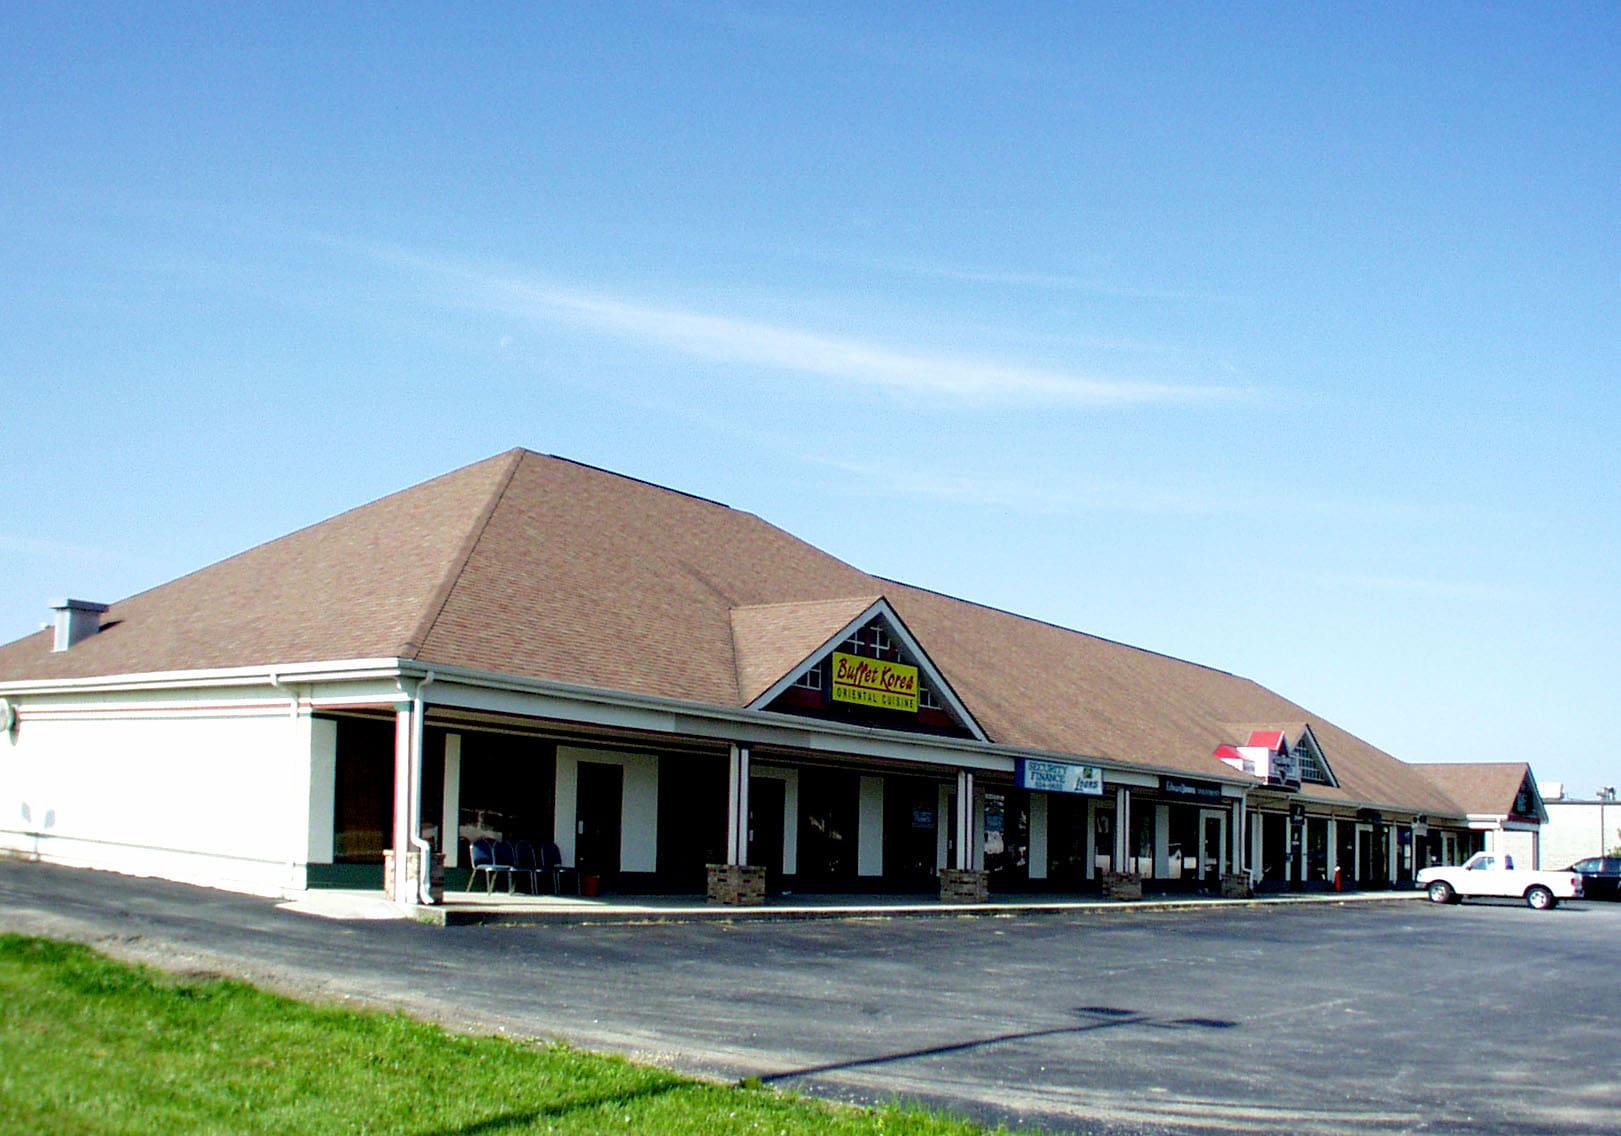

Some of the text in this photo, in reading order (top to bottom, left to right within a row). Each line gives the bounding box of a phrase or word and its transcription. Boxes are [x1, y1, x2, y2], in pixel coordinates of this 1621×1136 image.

[837, 658, 914, 691] Buffet Korea
[836, 687, 914, 709] ORIENTAL CUISINE
[1028, 761, 1068, 775] SECURITY
[1030, 771, 1065, 784] FINANCE
[1074, 776, 1098, 791] Loans
